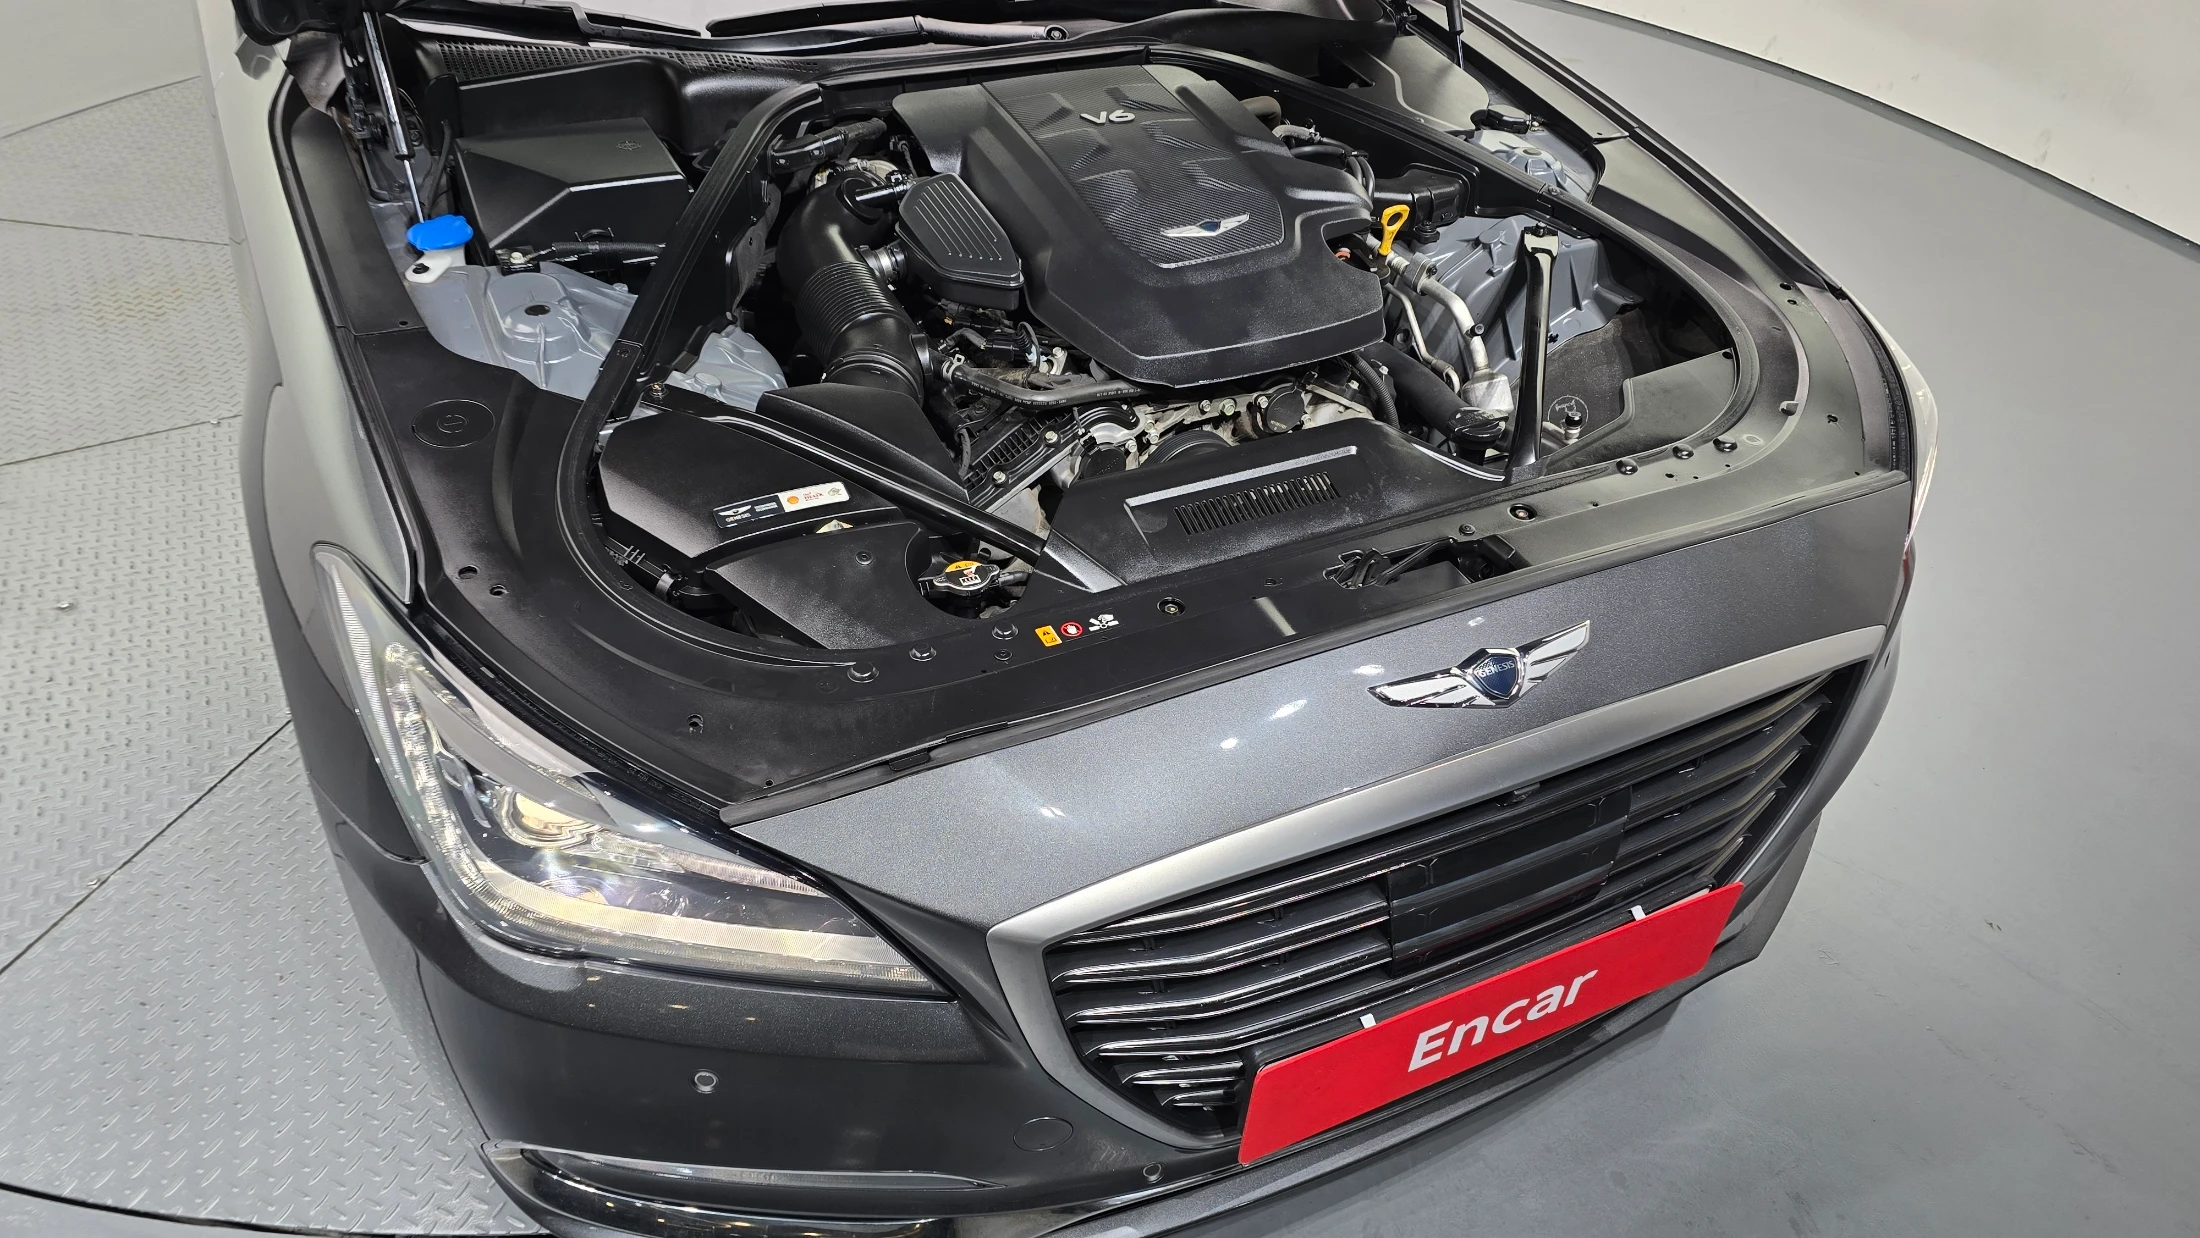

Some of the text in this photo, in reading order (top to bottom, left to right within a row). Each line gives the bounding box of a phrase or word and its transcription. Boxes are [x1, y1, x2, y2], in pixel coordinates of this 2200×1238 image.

[1079, 109, 1136, 125] V6
[1479, 661, 1515, 678] GENESIS
[1407, 969, 1599, 1073] Encar
